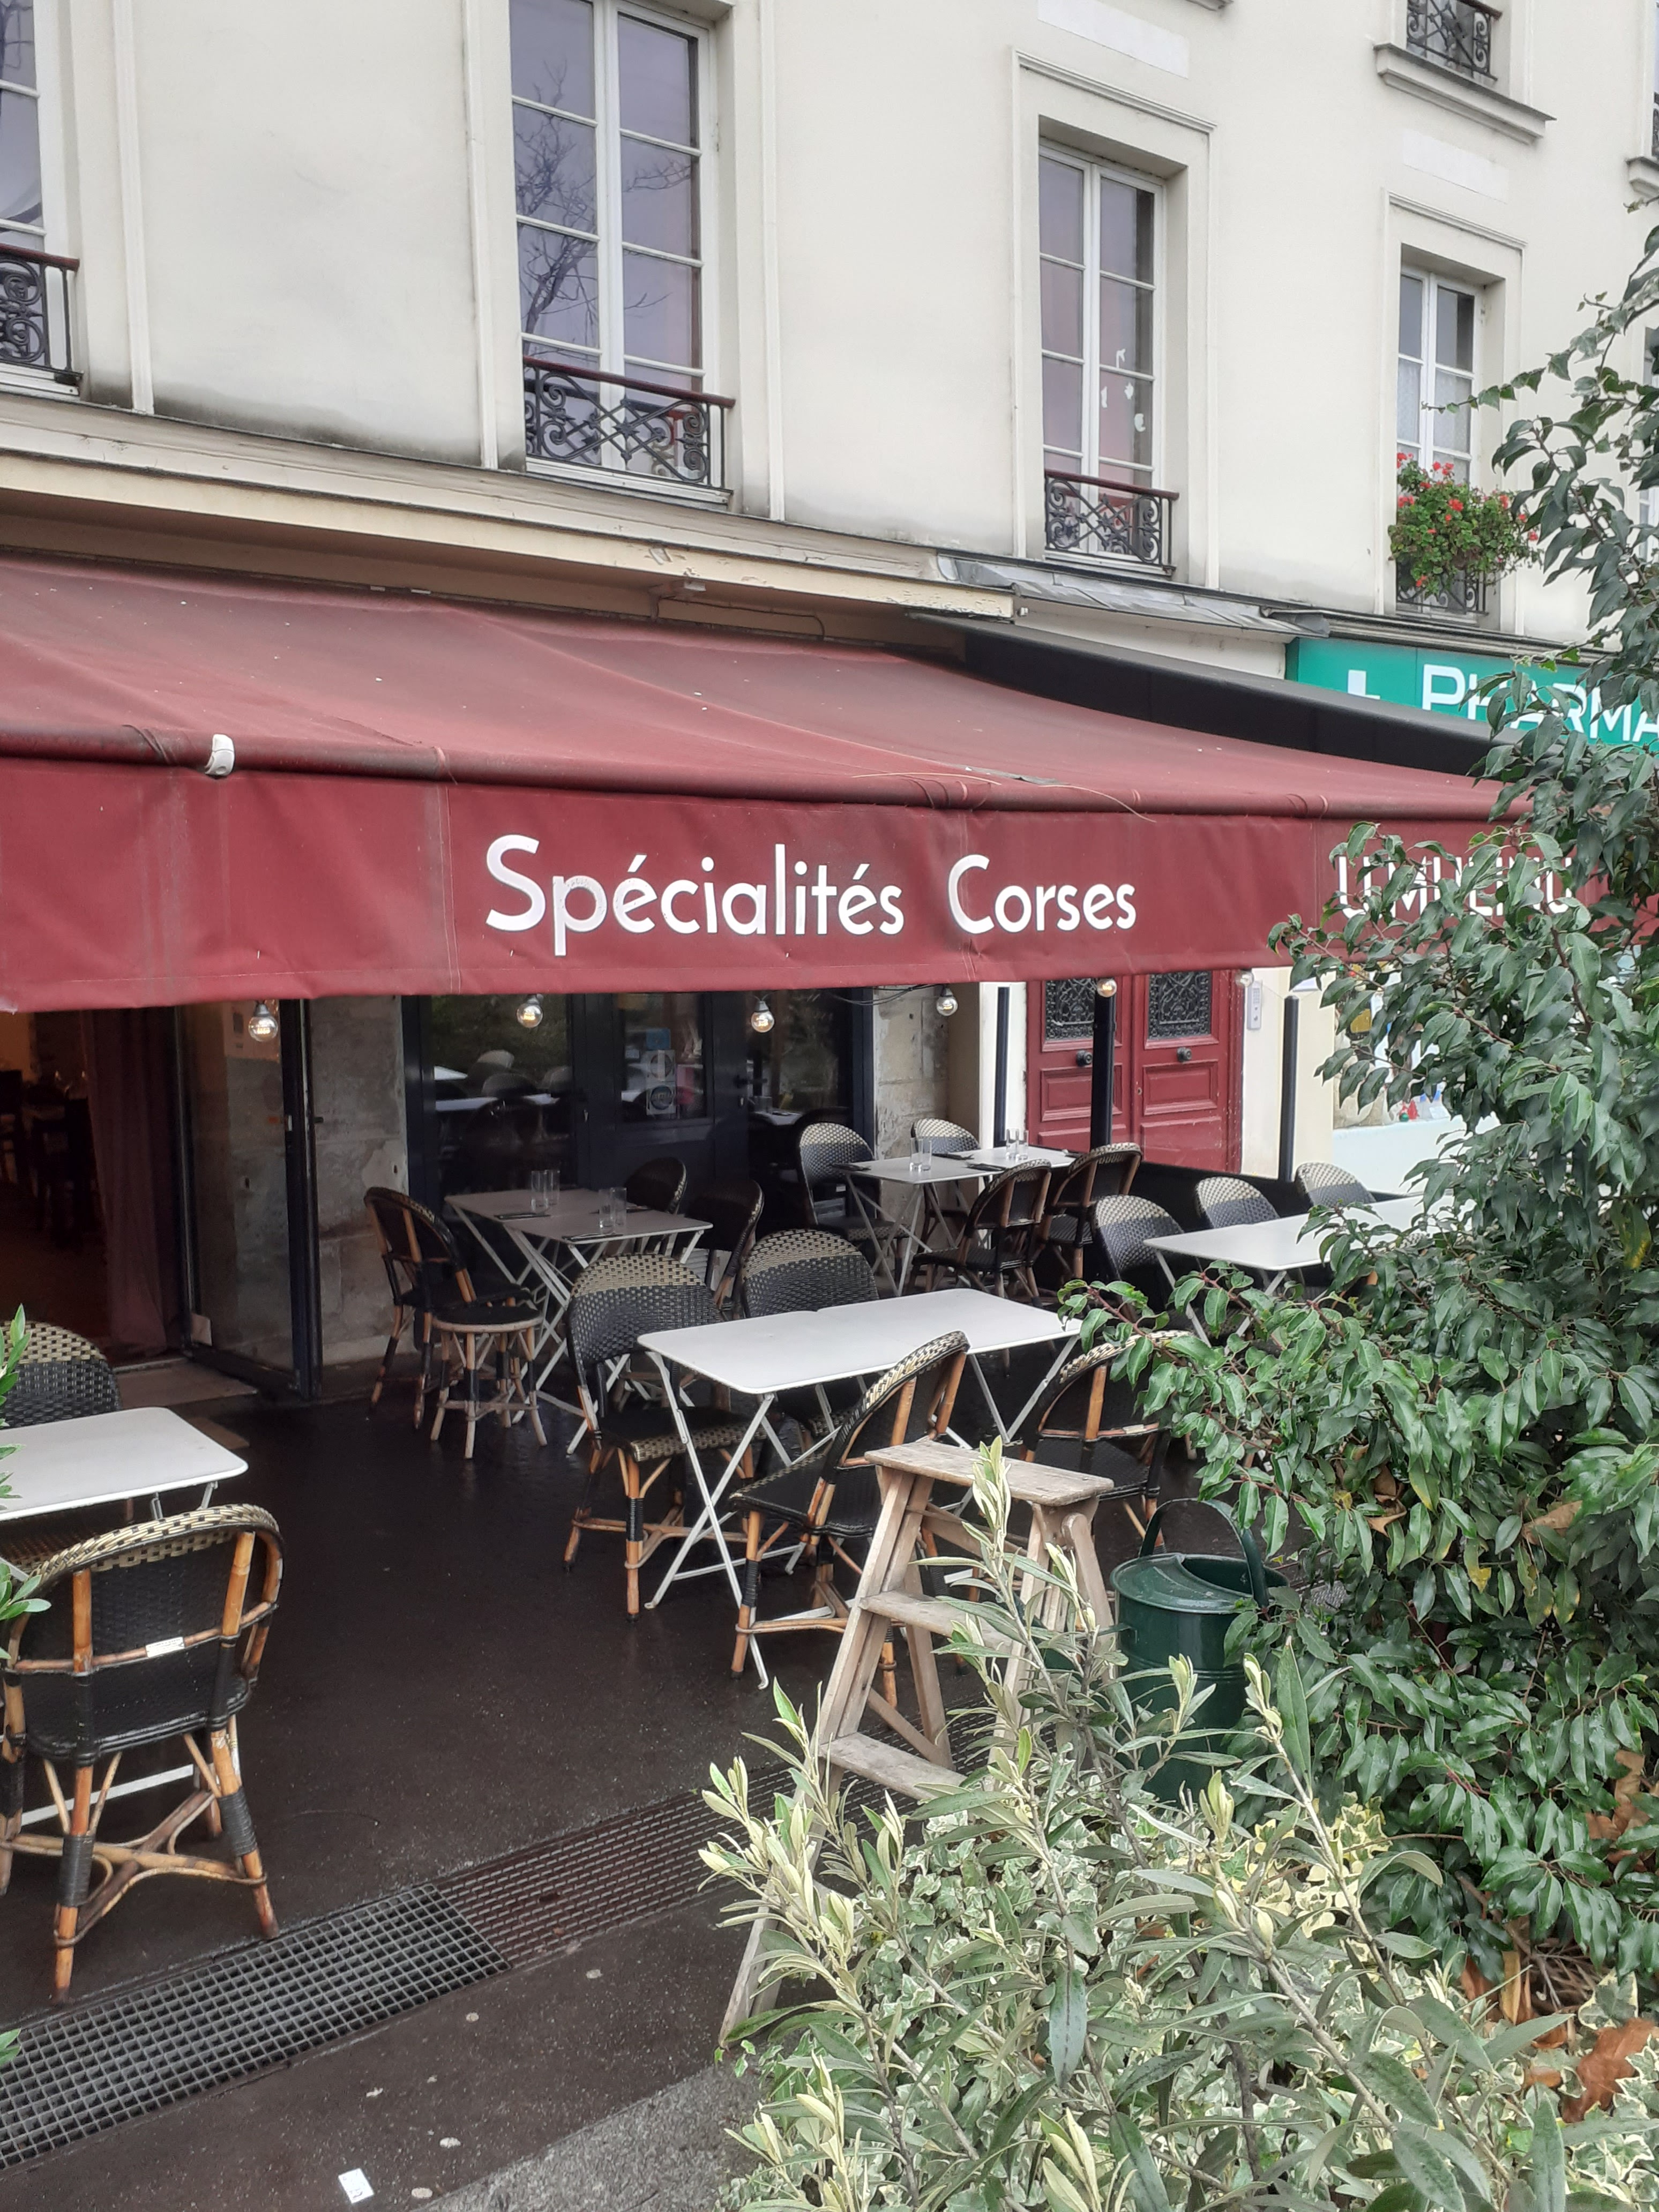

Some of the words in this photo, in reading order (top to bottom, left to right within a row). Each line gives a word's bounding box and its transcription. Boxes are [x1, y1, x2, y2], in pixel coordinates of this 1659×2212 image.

[485, 834, 904, 956] Spécialités
[948, 854, 1137, 934] Corses
[1388, 856, 1572, 916] MULIU
